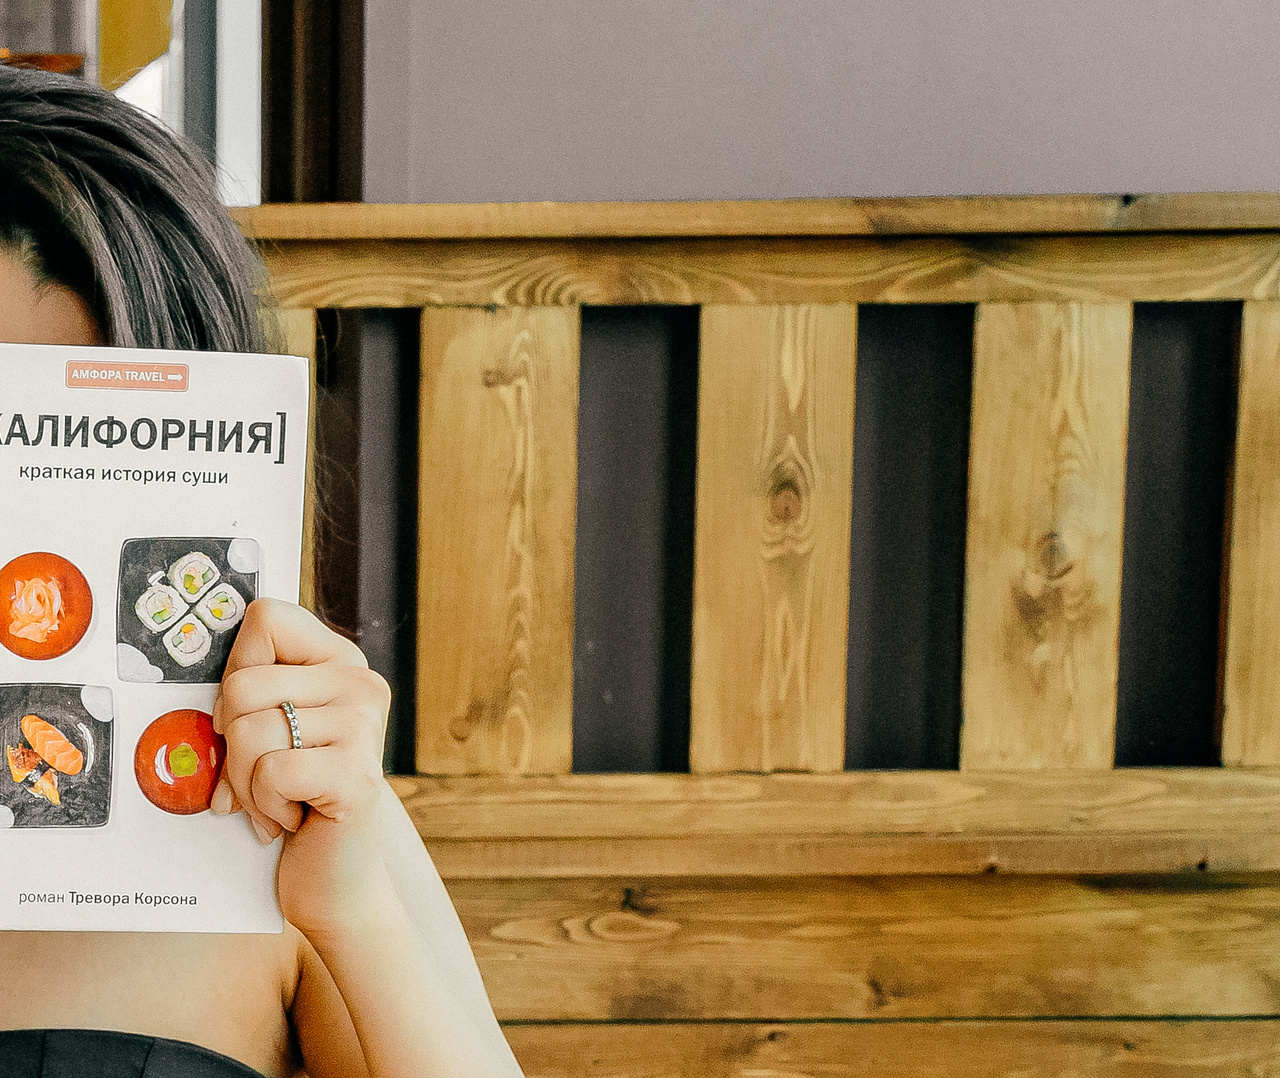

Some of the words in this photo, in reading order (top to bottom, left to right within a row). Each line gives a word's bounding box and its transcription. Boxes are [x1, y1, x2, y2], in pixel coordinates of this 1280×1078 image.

[71, 368, 122, 381] АМФОРА
[124, 370, 166, 383] TRAVEL
[19, 464, 96, 482] краткая
[101, 467, 177, 486] история
[182, 472, 229, 487] суши
[18, 892, 65, 905] роман
[69, 891, 130, 906] Тревора
[134, 892, 198, 907] Корсона
